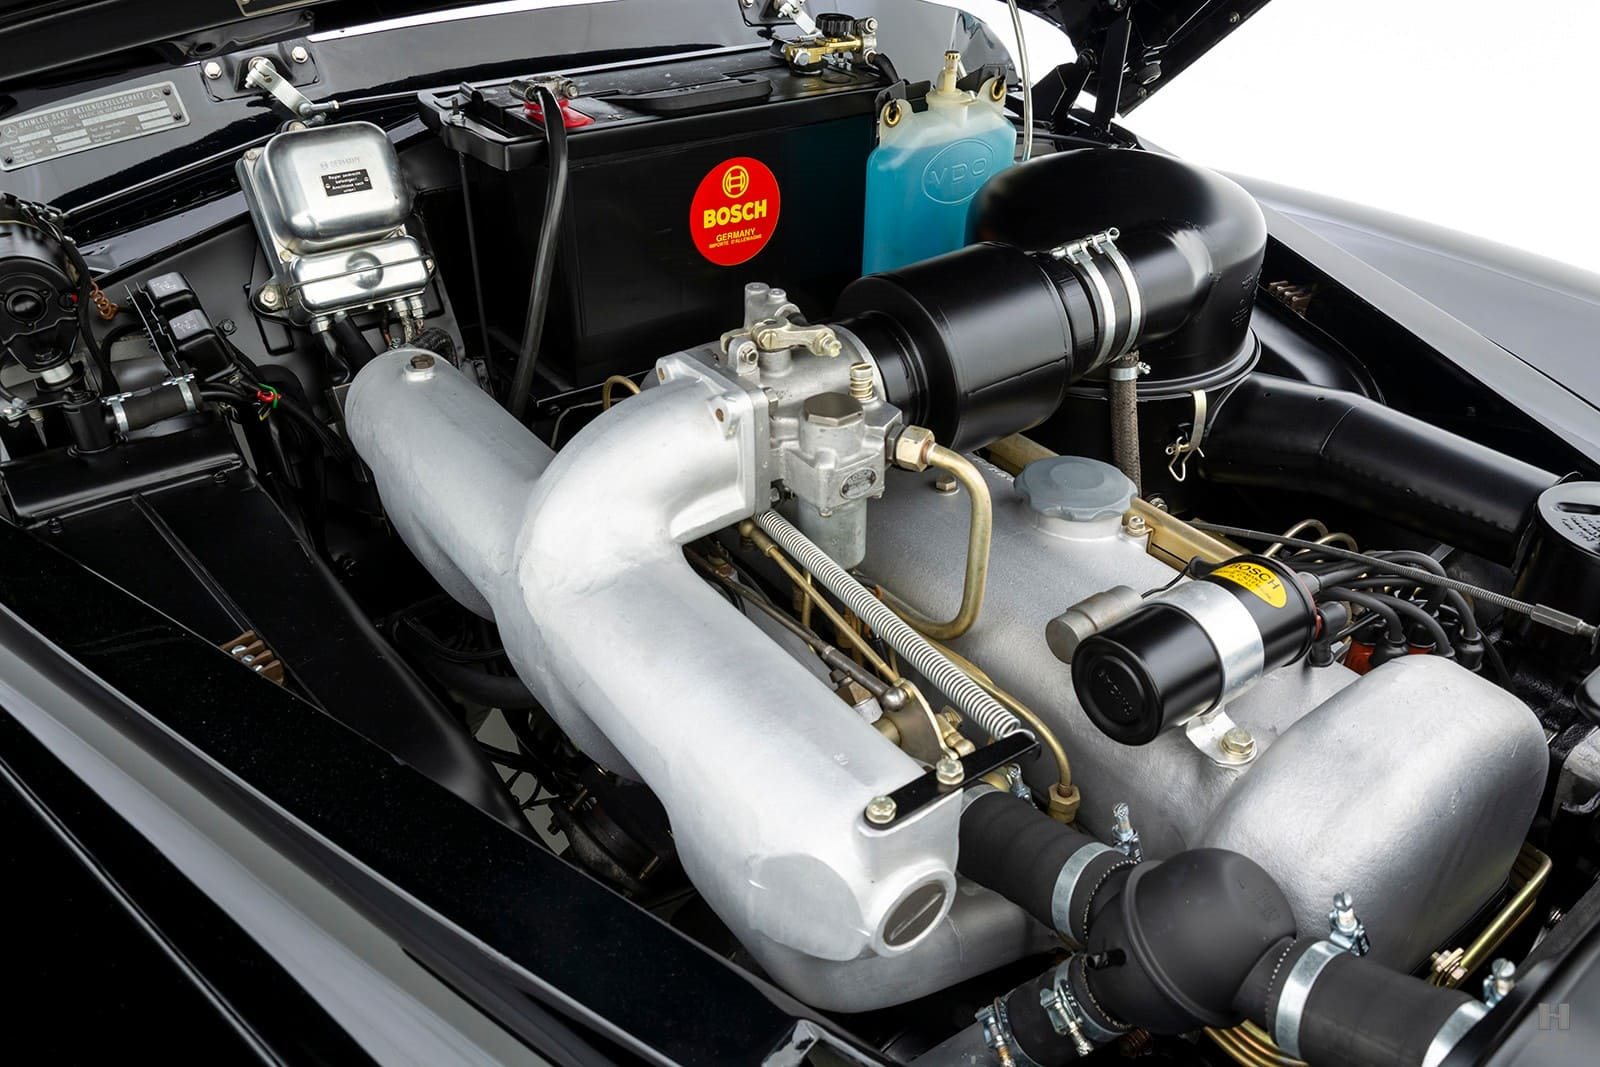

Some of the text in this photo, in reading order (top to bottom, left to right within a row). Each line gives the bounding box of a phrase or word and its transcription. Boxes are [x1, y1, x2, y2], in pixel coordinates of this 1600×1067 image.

[931, 157, 986, 184] VDO
[704, 199, 767, 229] BOSCH
[715, 227, 756, 242] GERMANY
[1229, 563, 1280, 589] BOSCH
